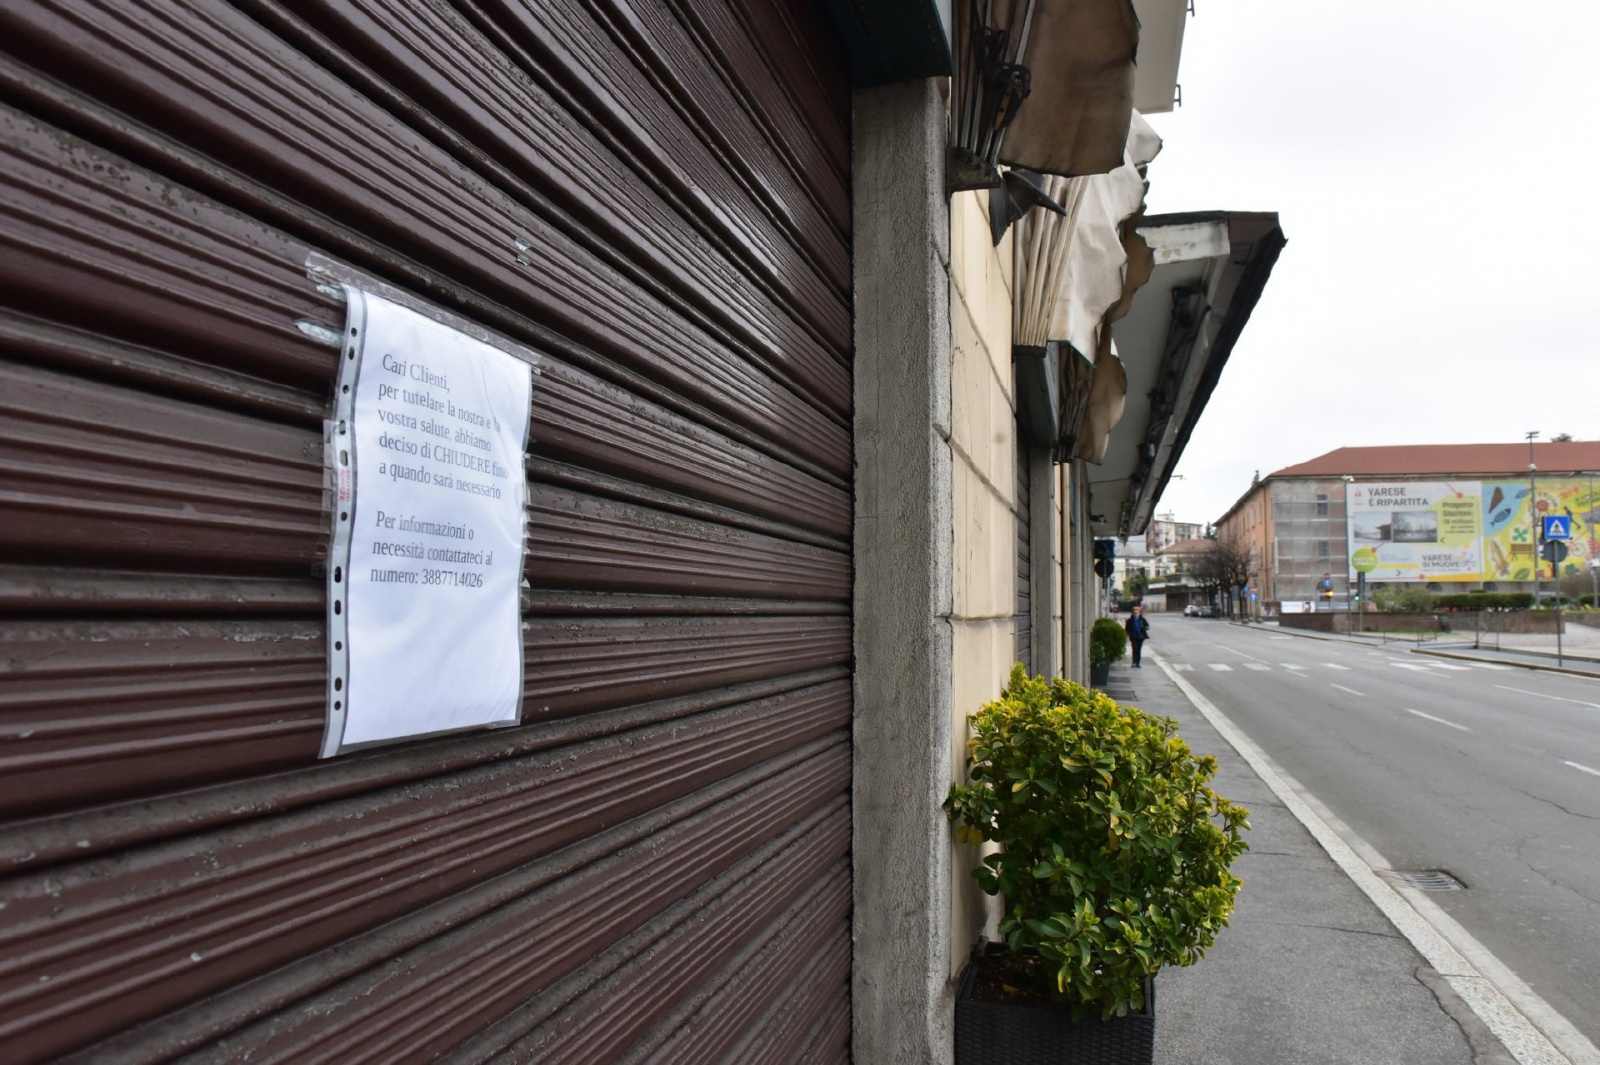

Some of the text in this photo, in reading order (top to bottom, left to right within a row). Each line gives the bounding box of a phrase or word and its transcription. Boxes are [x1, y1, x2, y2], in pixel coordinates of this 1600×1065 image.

[382, 354, 450, 393] Cari Clienti,
[378, 383, 399, 400] per
[403, 389, 444, 413] tutelare
[447, 400, 455, 417] la
[458, 407, 484, 427] nostra
[486, 419, 491, 429] e
[378, 409, 492, 450] vostra salute, abbiamo
[379, 431, 509, 479] deciso di CHIUDERE fino
[379, 462, 501, 500] a quando sarà necessario
[1368, 487, 1406, 496] VARESE
[1377, 498, 1429, 507] RIPARTITA
[375, 510, 474, 541] Per informazioni o
[372, 541, 493, 566] necessità contattateci al
[370, 568, 483, 588] numero: 3887714026
